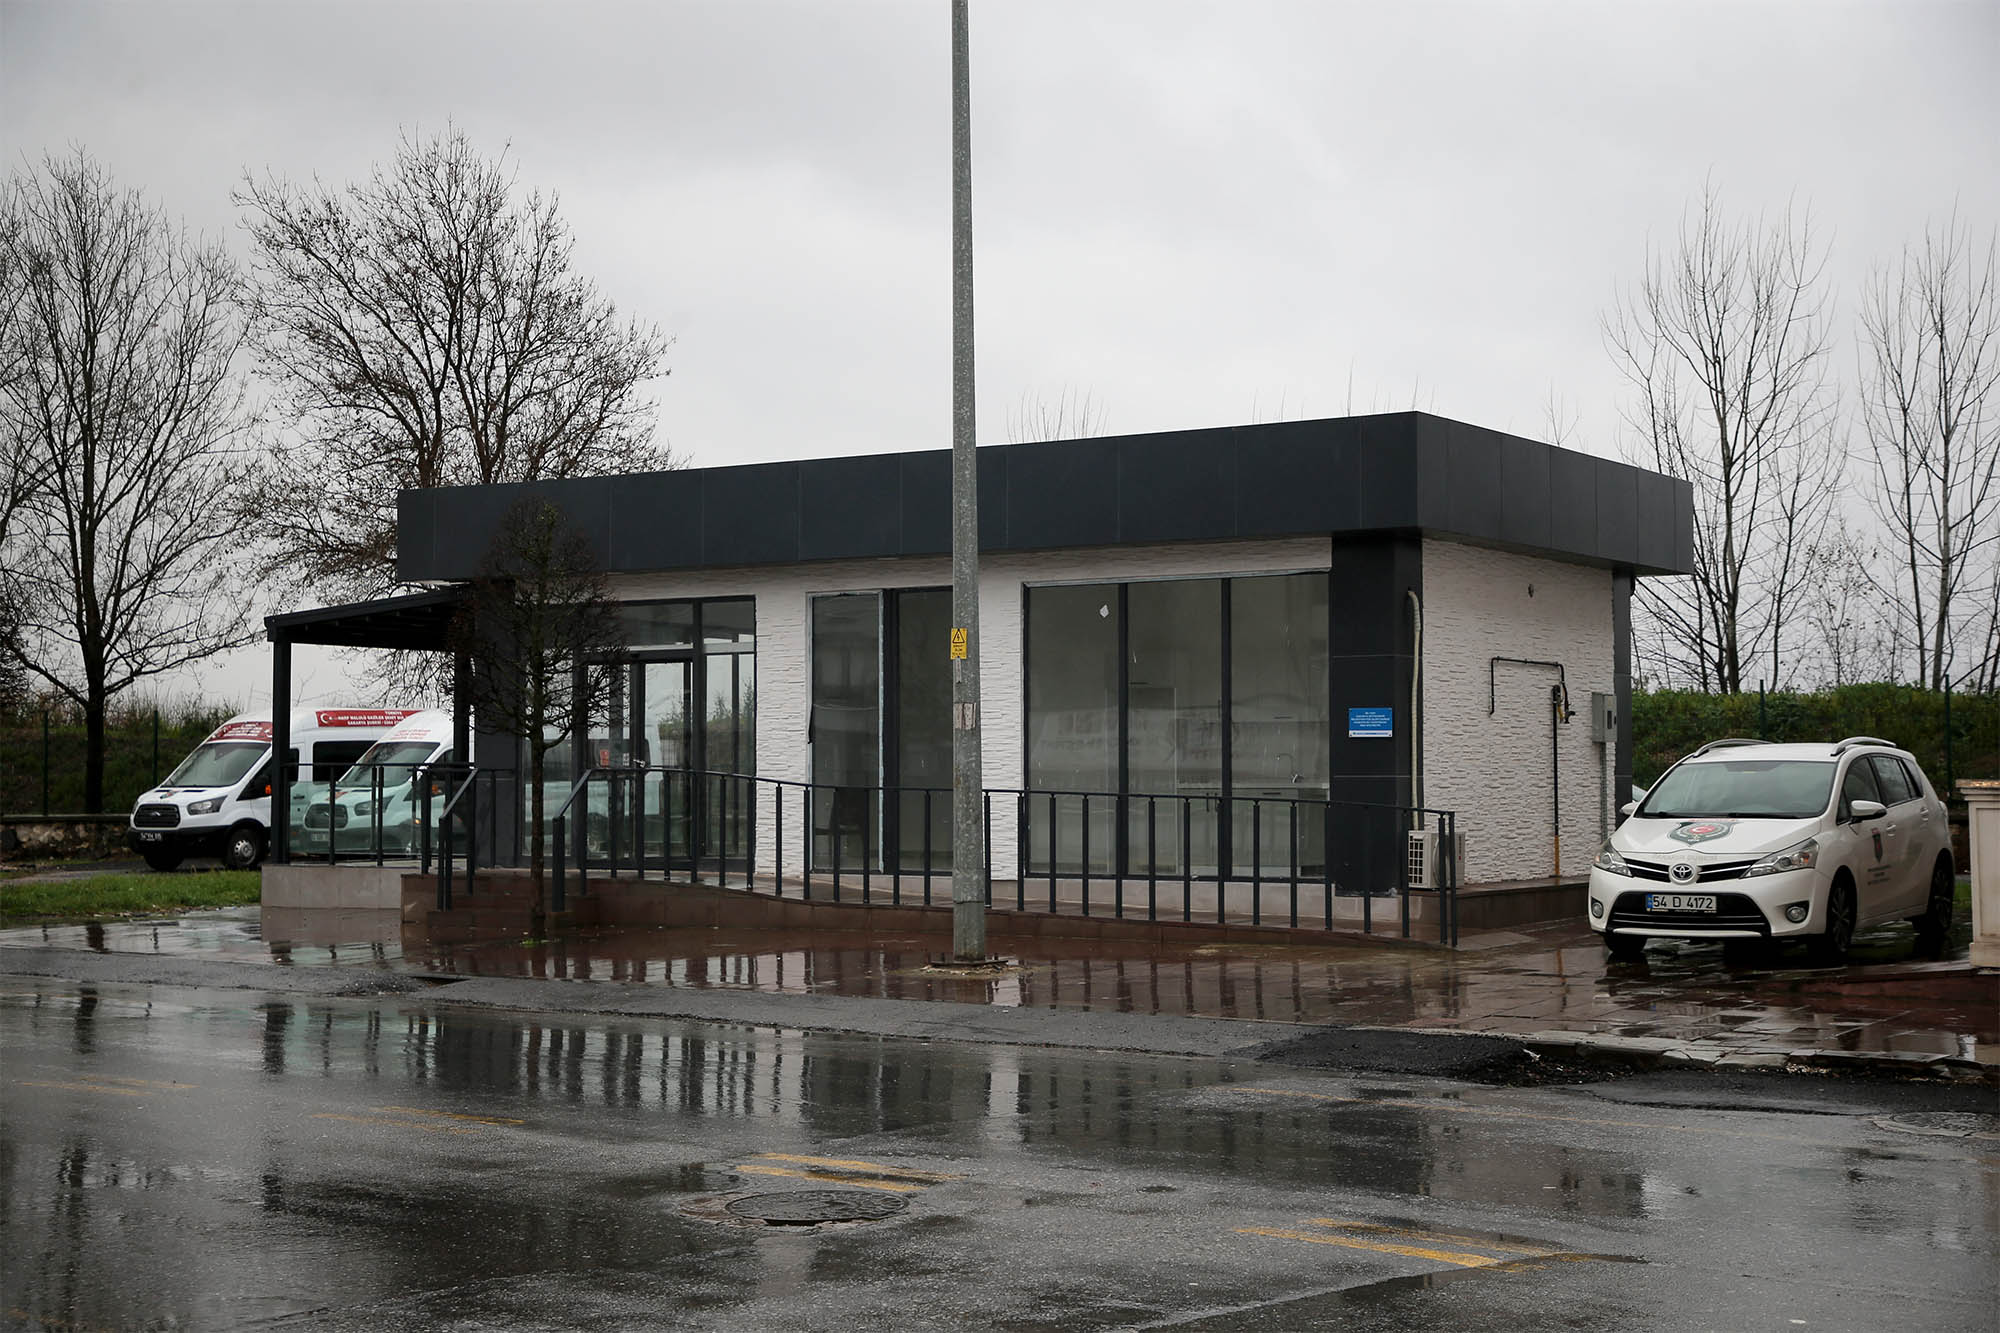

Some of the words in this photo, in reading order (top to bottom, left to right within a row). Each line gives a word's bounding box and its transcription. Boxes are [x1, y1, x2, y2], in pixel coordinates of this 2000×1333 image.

[1653, 896, 1667, 907] 54
[1673, 896, 1681, 908] D
[1687, 897, 1713, 909] 4172
